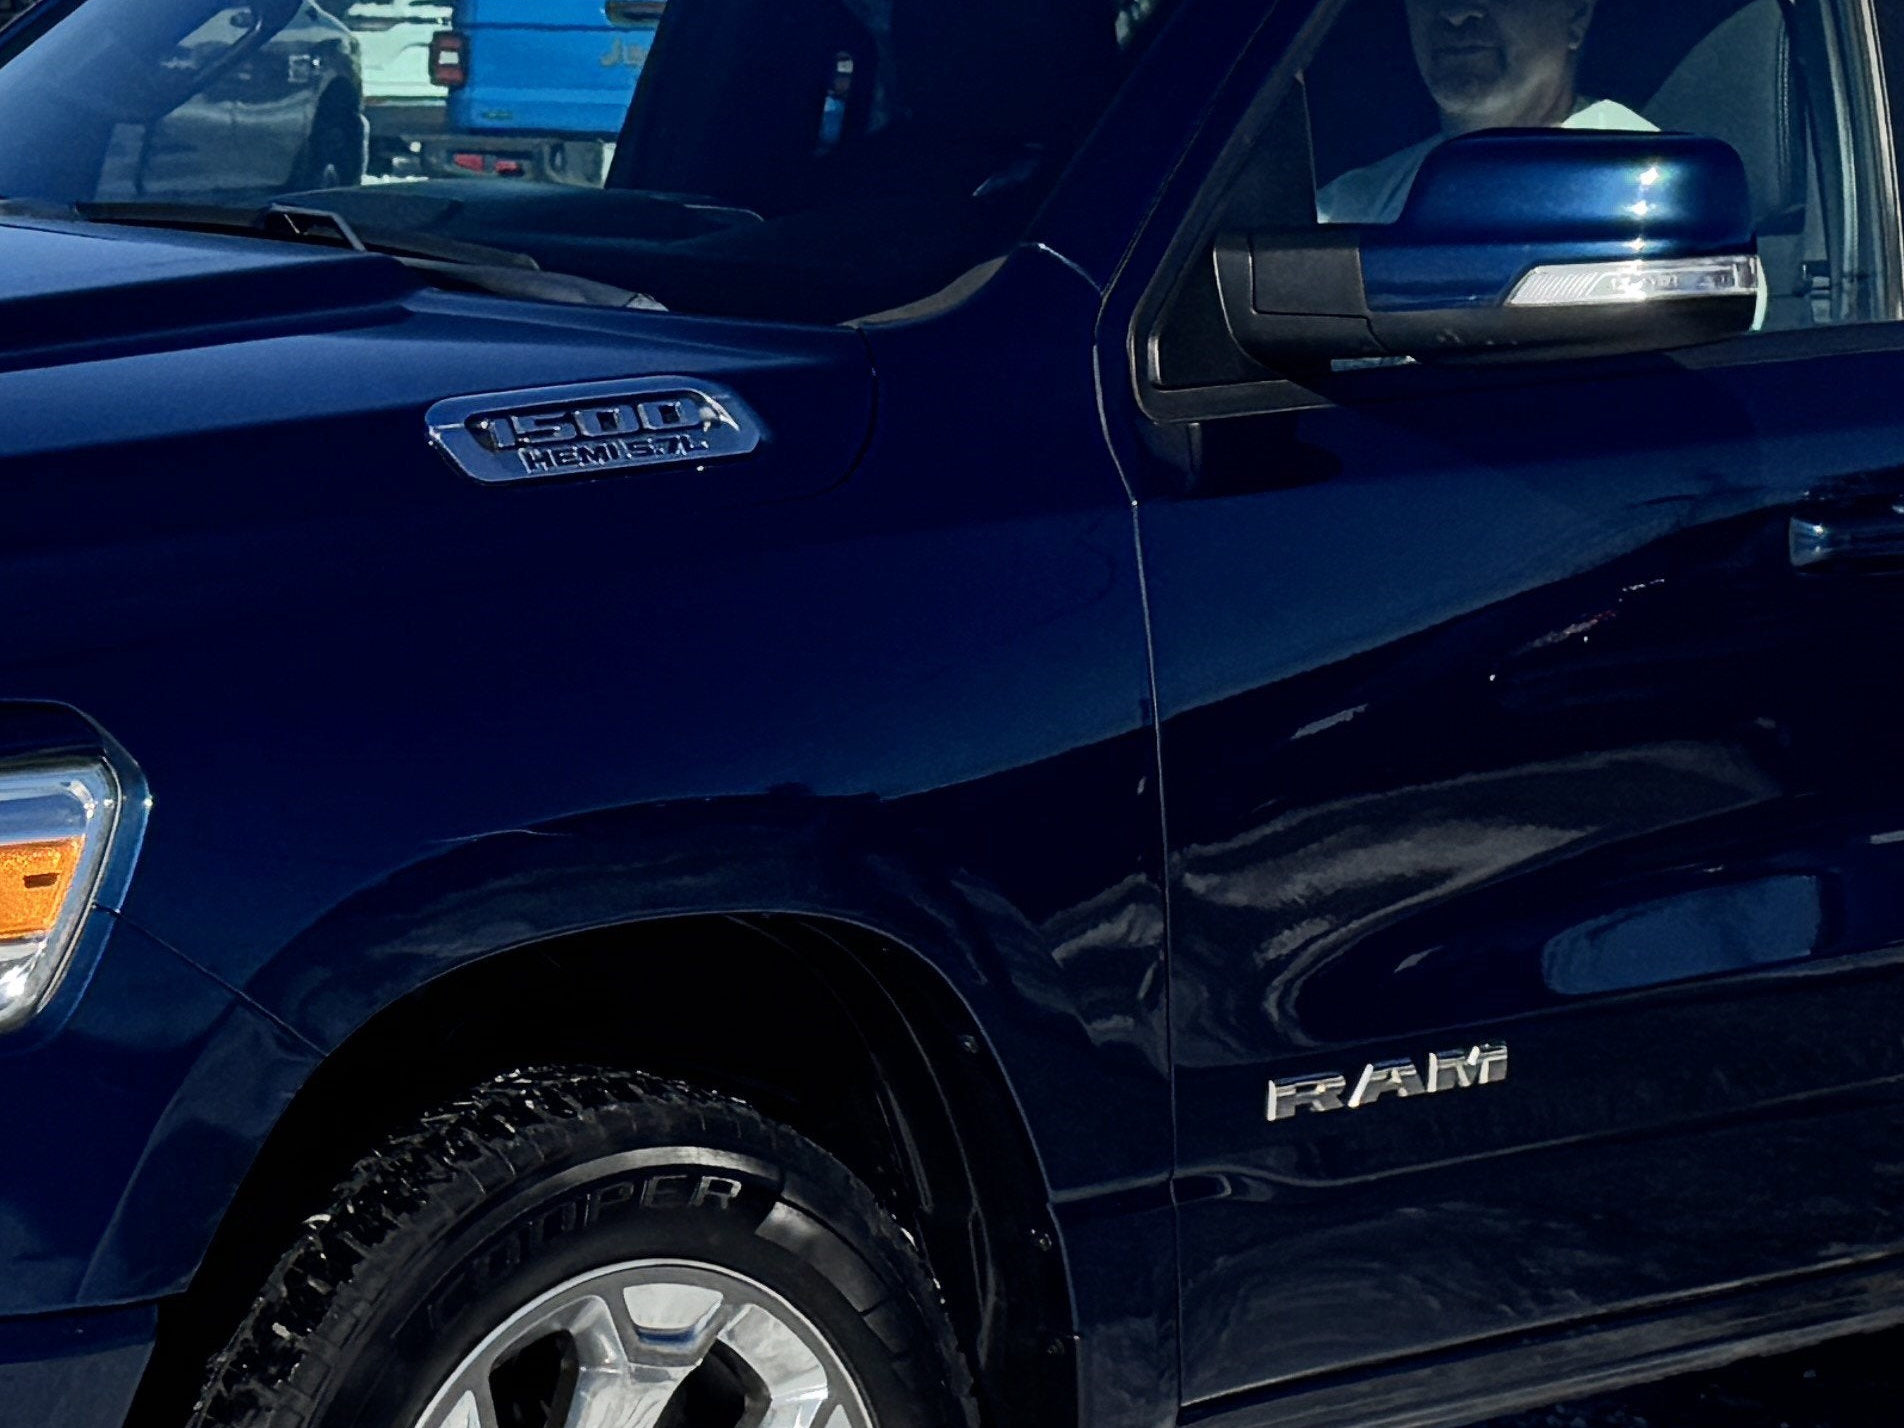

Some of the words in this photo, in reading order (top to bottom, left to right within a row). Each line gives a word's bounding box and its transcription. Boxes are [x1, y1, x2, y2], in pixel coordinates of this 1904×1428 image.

[482, 398, 702, 449] 1500
[517, 438, 630, 475] HEMI
[1266, 1040, 1508, 1122] RAM
